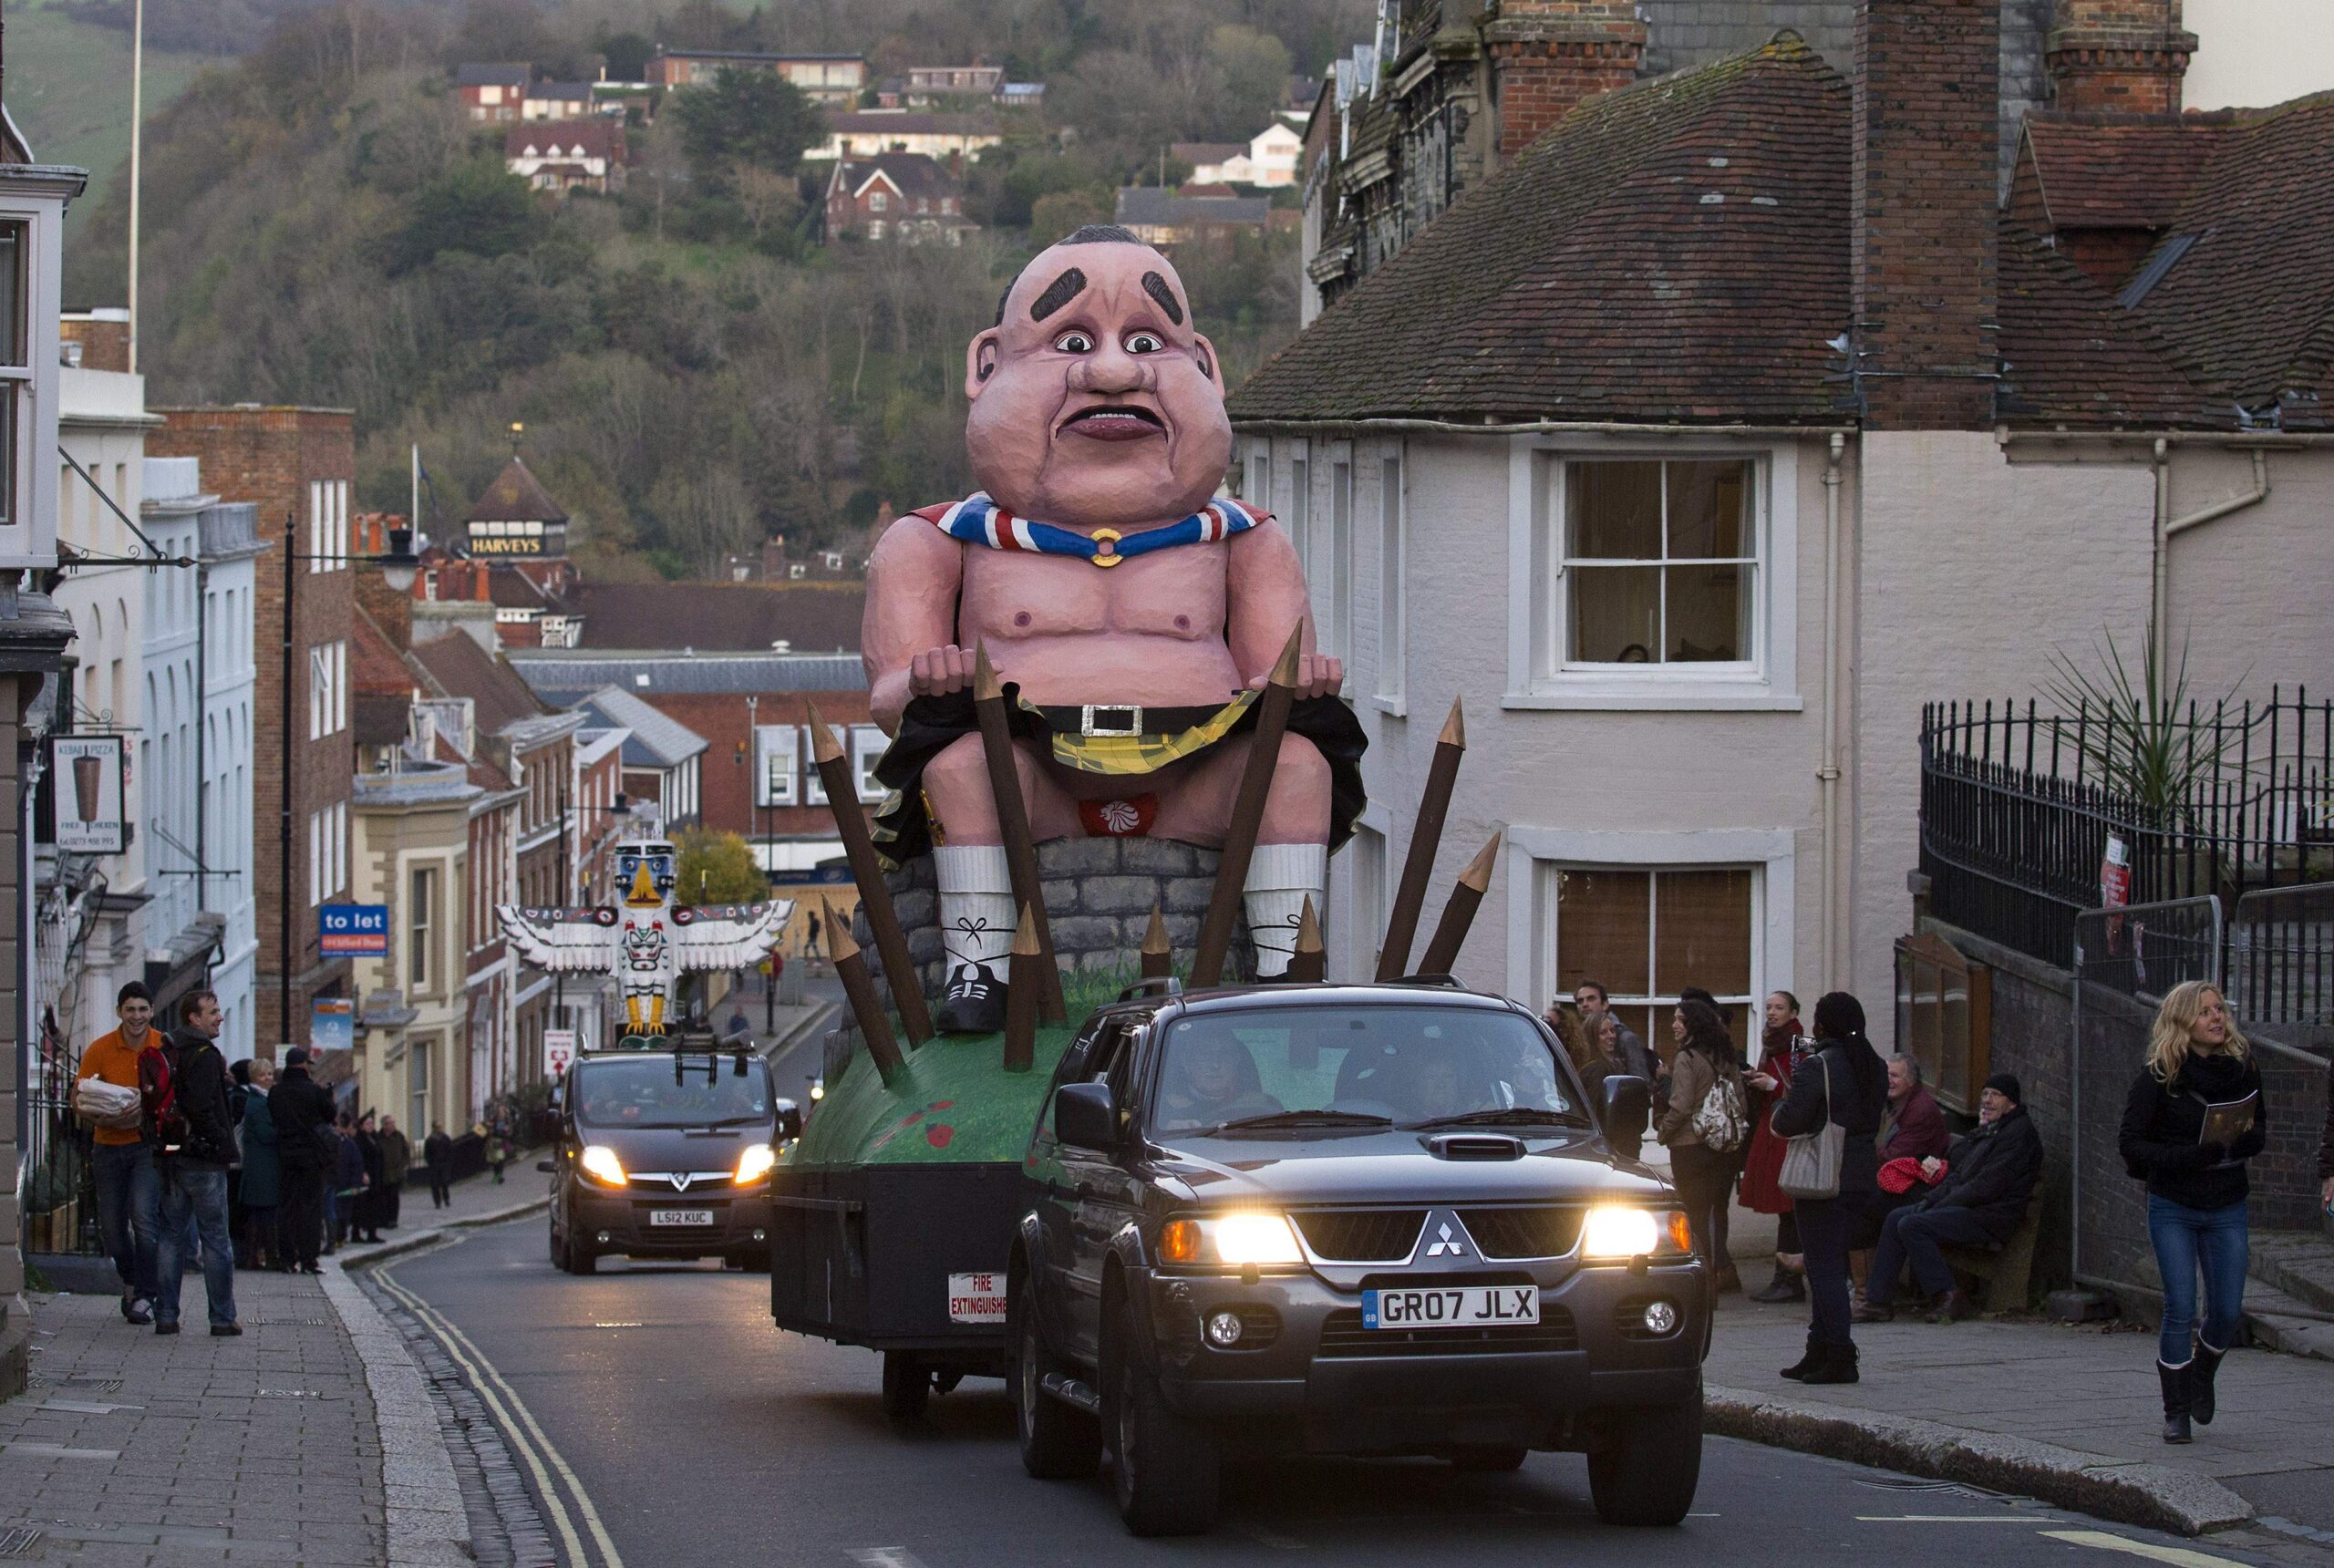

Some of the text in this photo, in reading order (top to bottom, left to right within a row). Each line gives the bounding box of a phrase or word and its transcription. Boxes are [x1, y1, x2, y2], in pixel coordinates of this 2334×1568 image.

[471, 539, 541, 553] HARVEYS
[58, 745, 115, 756] KEBAB PIZZA
[325, 913, 382, 929] to let
[656, 1212, 706, 1223] LS12 KUC
[973, 1274, 992, 1292] FIRE
[1384, 1289, 1534, 1322] GR07 JLX
[1365, 1314, 1376, 1323] GB
